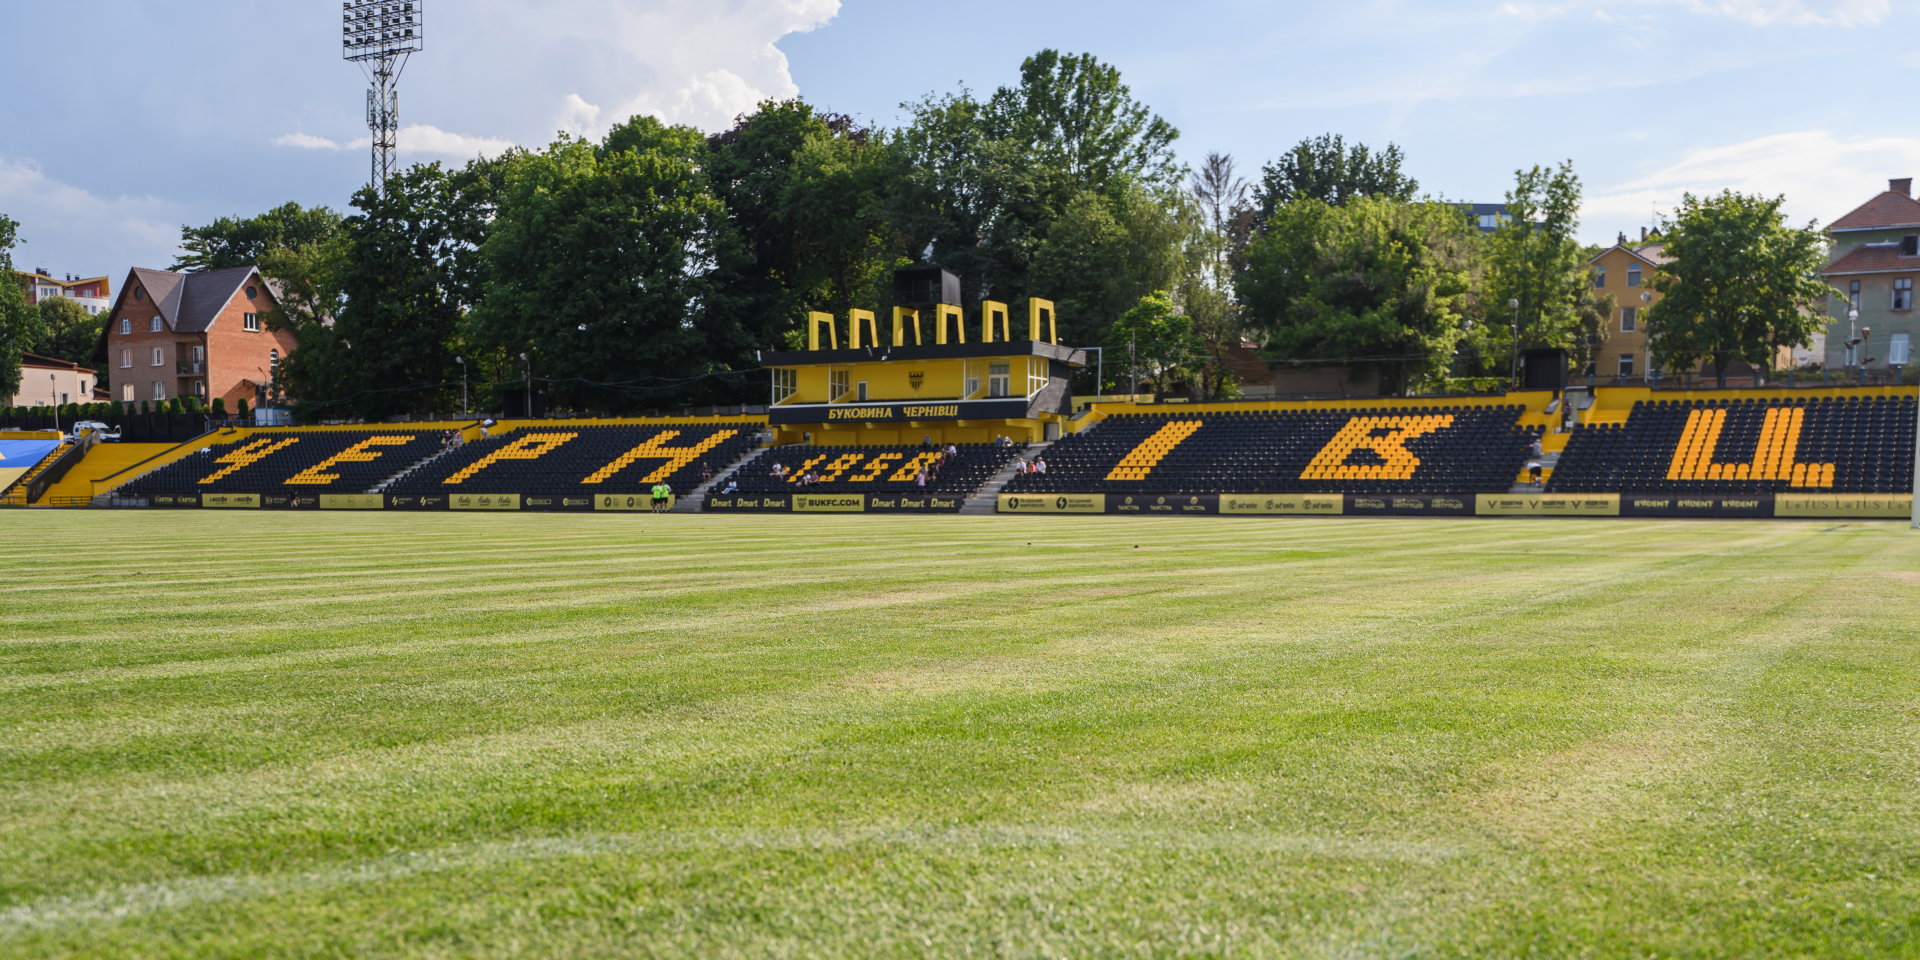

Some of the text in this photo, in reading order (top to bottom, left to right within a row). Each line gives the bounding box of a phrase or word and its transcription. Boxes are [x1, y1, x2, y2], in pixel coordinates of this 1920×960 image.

[828, 404, 959, 420] БУКОВИНА ЧЕРНІВЦІ
[710, 498, 786, 508] Dmart Dmart Dmart
[808, 498, 860, 507] BUKFC.COM
[872, 498, 956, 508] Dmart Dmart Dmart
